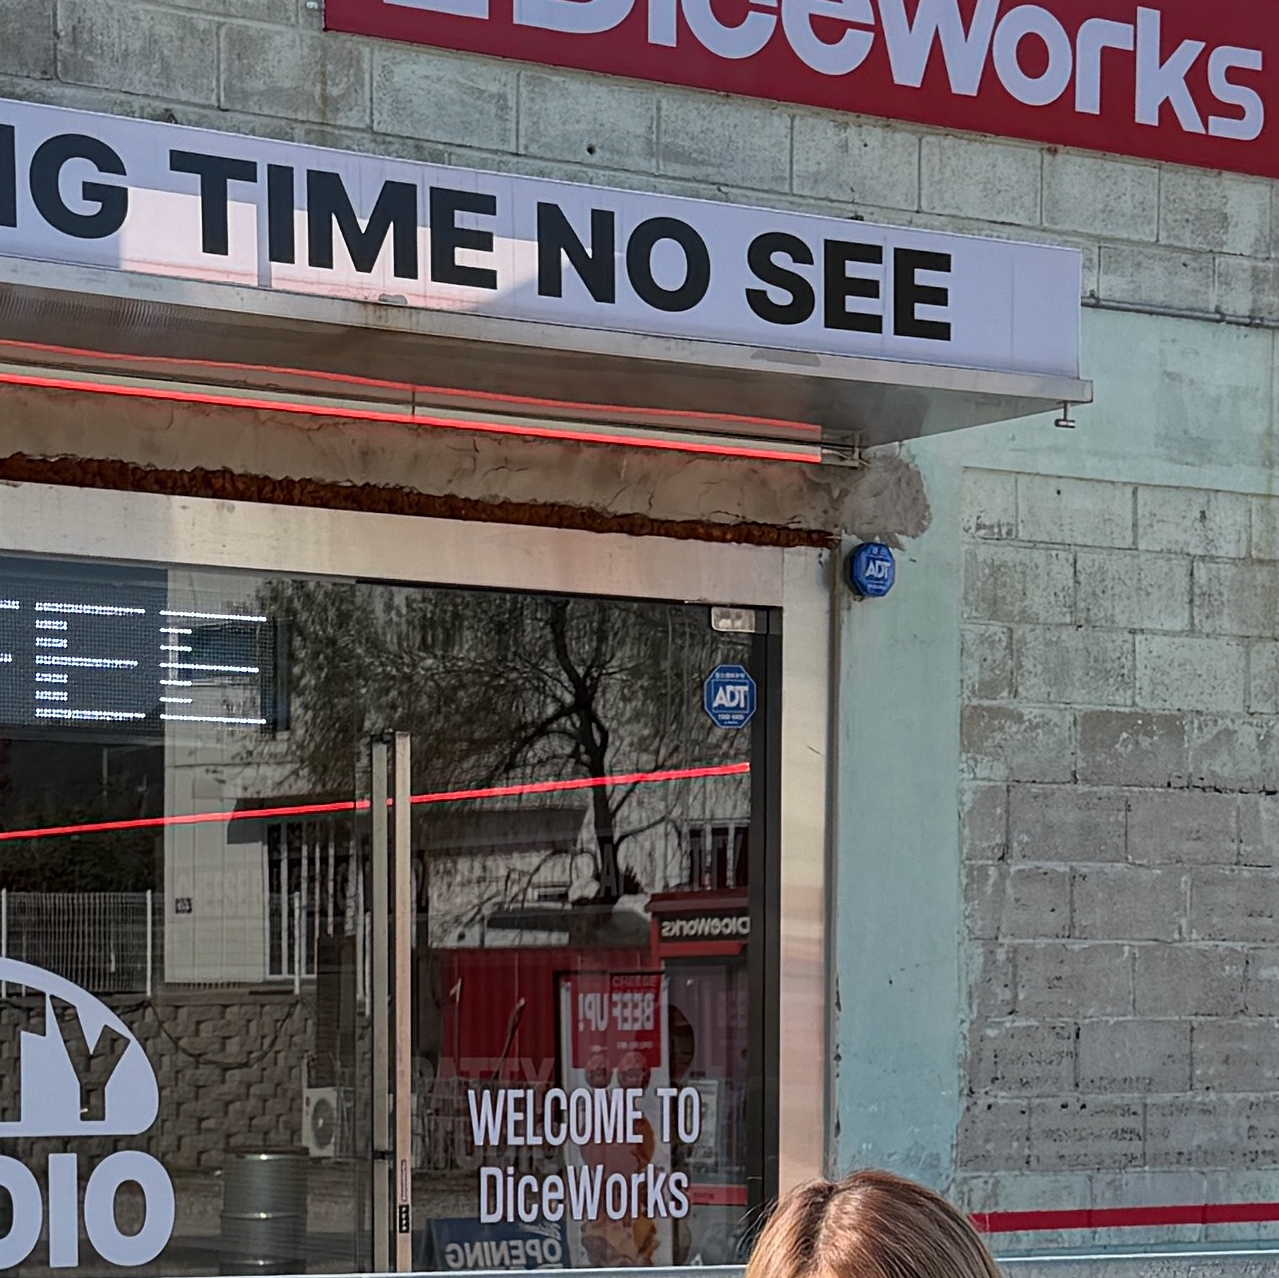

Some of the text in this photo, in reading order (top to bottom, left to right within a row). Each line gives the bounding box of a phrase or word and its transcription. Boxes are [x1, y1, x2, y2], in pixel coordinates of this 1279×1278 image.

[512, 0, 1265, 142] ceWorks
[168, 148, 498, 290] TIME
[536, 201, 712, 313] NO
[744, 231, 952, 342] SEE
[864, 560, 891, 579] ADT
[712, 684, 749, 709] ADT
[467, 1087, 644, 1147] WELCOME
[656, 1086, 702, 1144] TO
[479, 1163, 690, 1224] DiceWorks
